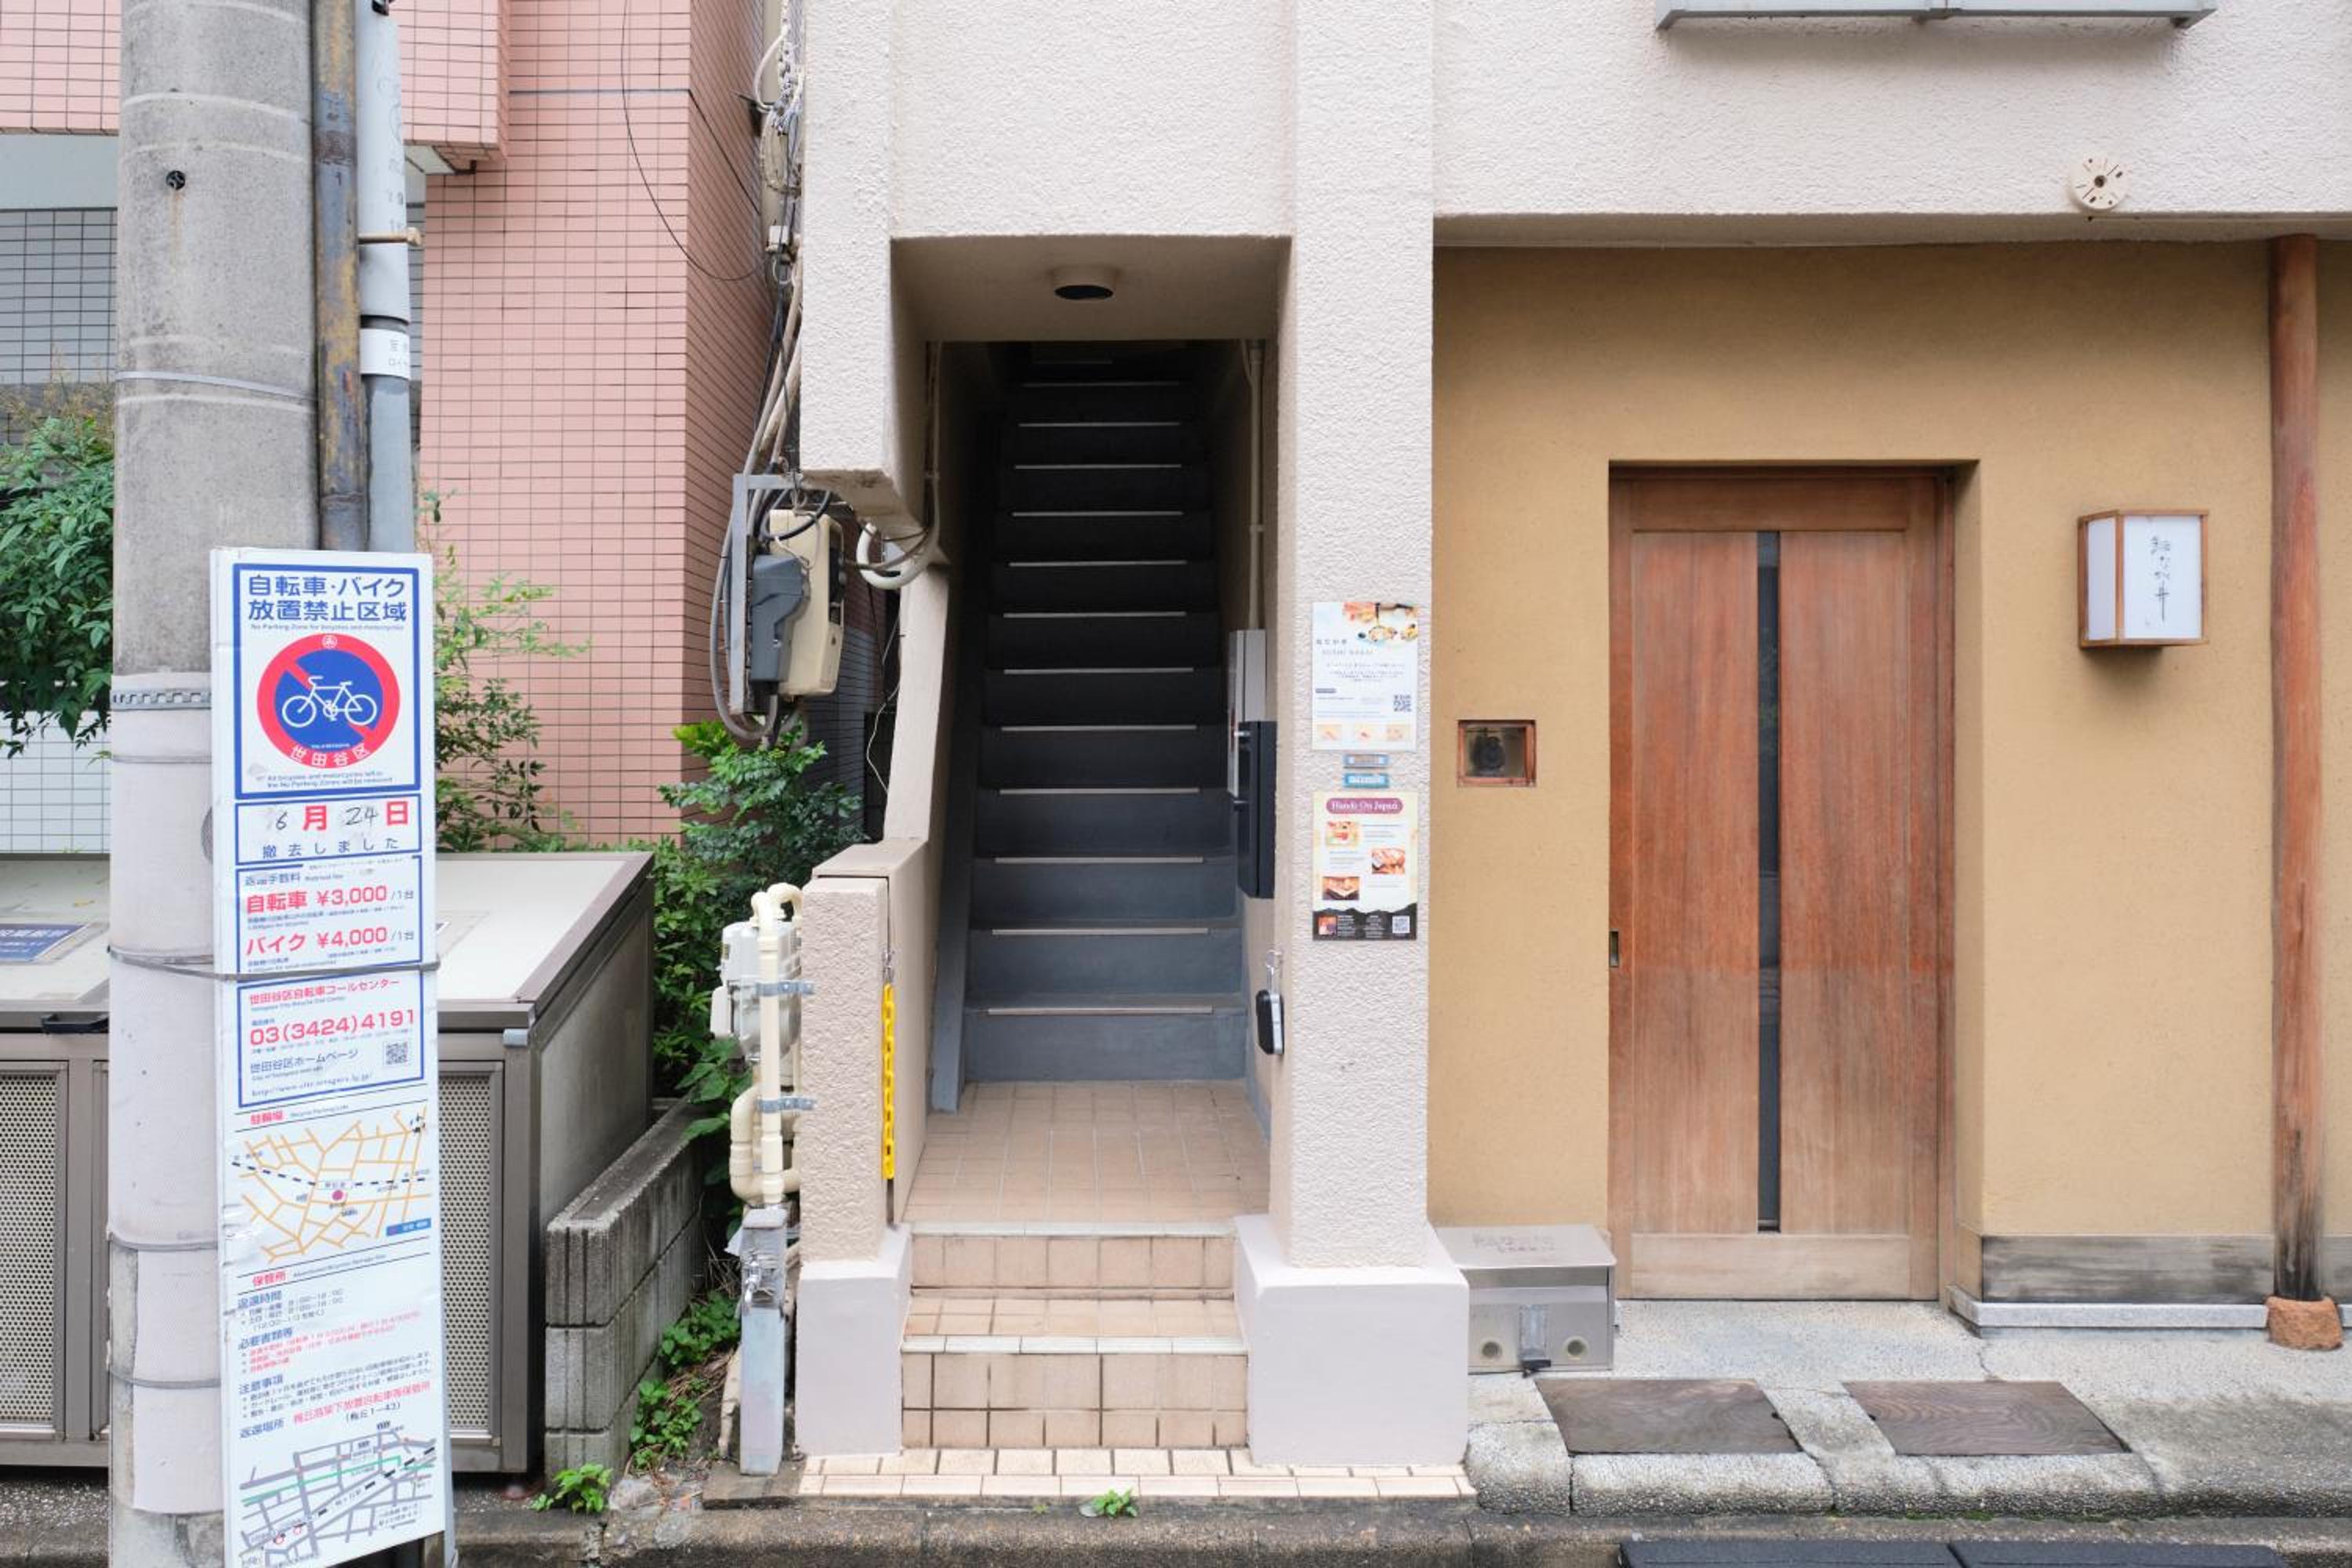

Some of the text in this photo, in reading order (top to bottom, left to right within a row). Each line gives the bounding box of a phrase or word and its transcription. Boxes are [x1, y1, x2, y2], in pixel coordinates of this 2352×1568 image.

[249, 575, 405, 597] 自転車・バイク
[249, 599, 407, 622] 放置禁止区域
[291, 742, 371, 767] 世田谷区
[1359, 801, 1373, 810] On
[1374, 800, 1399, 811] Japan
[263, 837, 401, 858] 撤去しました
[246, 890, 308, 914] 自転車
[317, 885, 387, 906] ¥3,000
[246, 933, 306, 956] バイク
[317, 927, 387, 949] ¥4,000
[250, 978, 401, 1006] 世田谷区自転車コールセンター
[250, 1009, 415, 1046] 03(3424)4191
[250, 1048, 358, 1074] 世田谷区ホームページ
